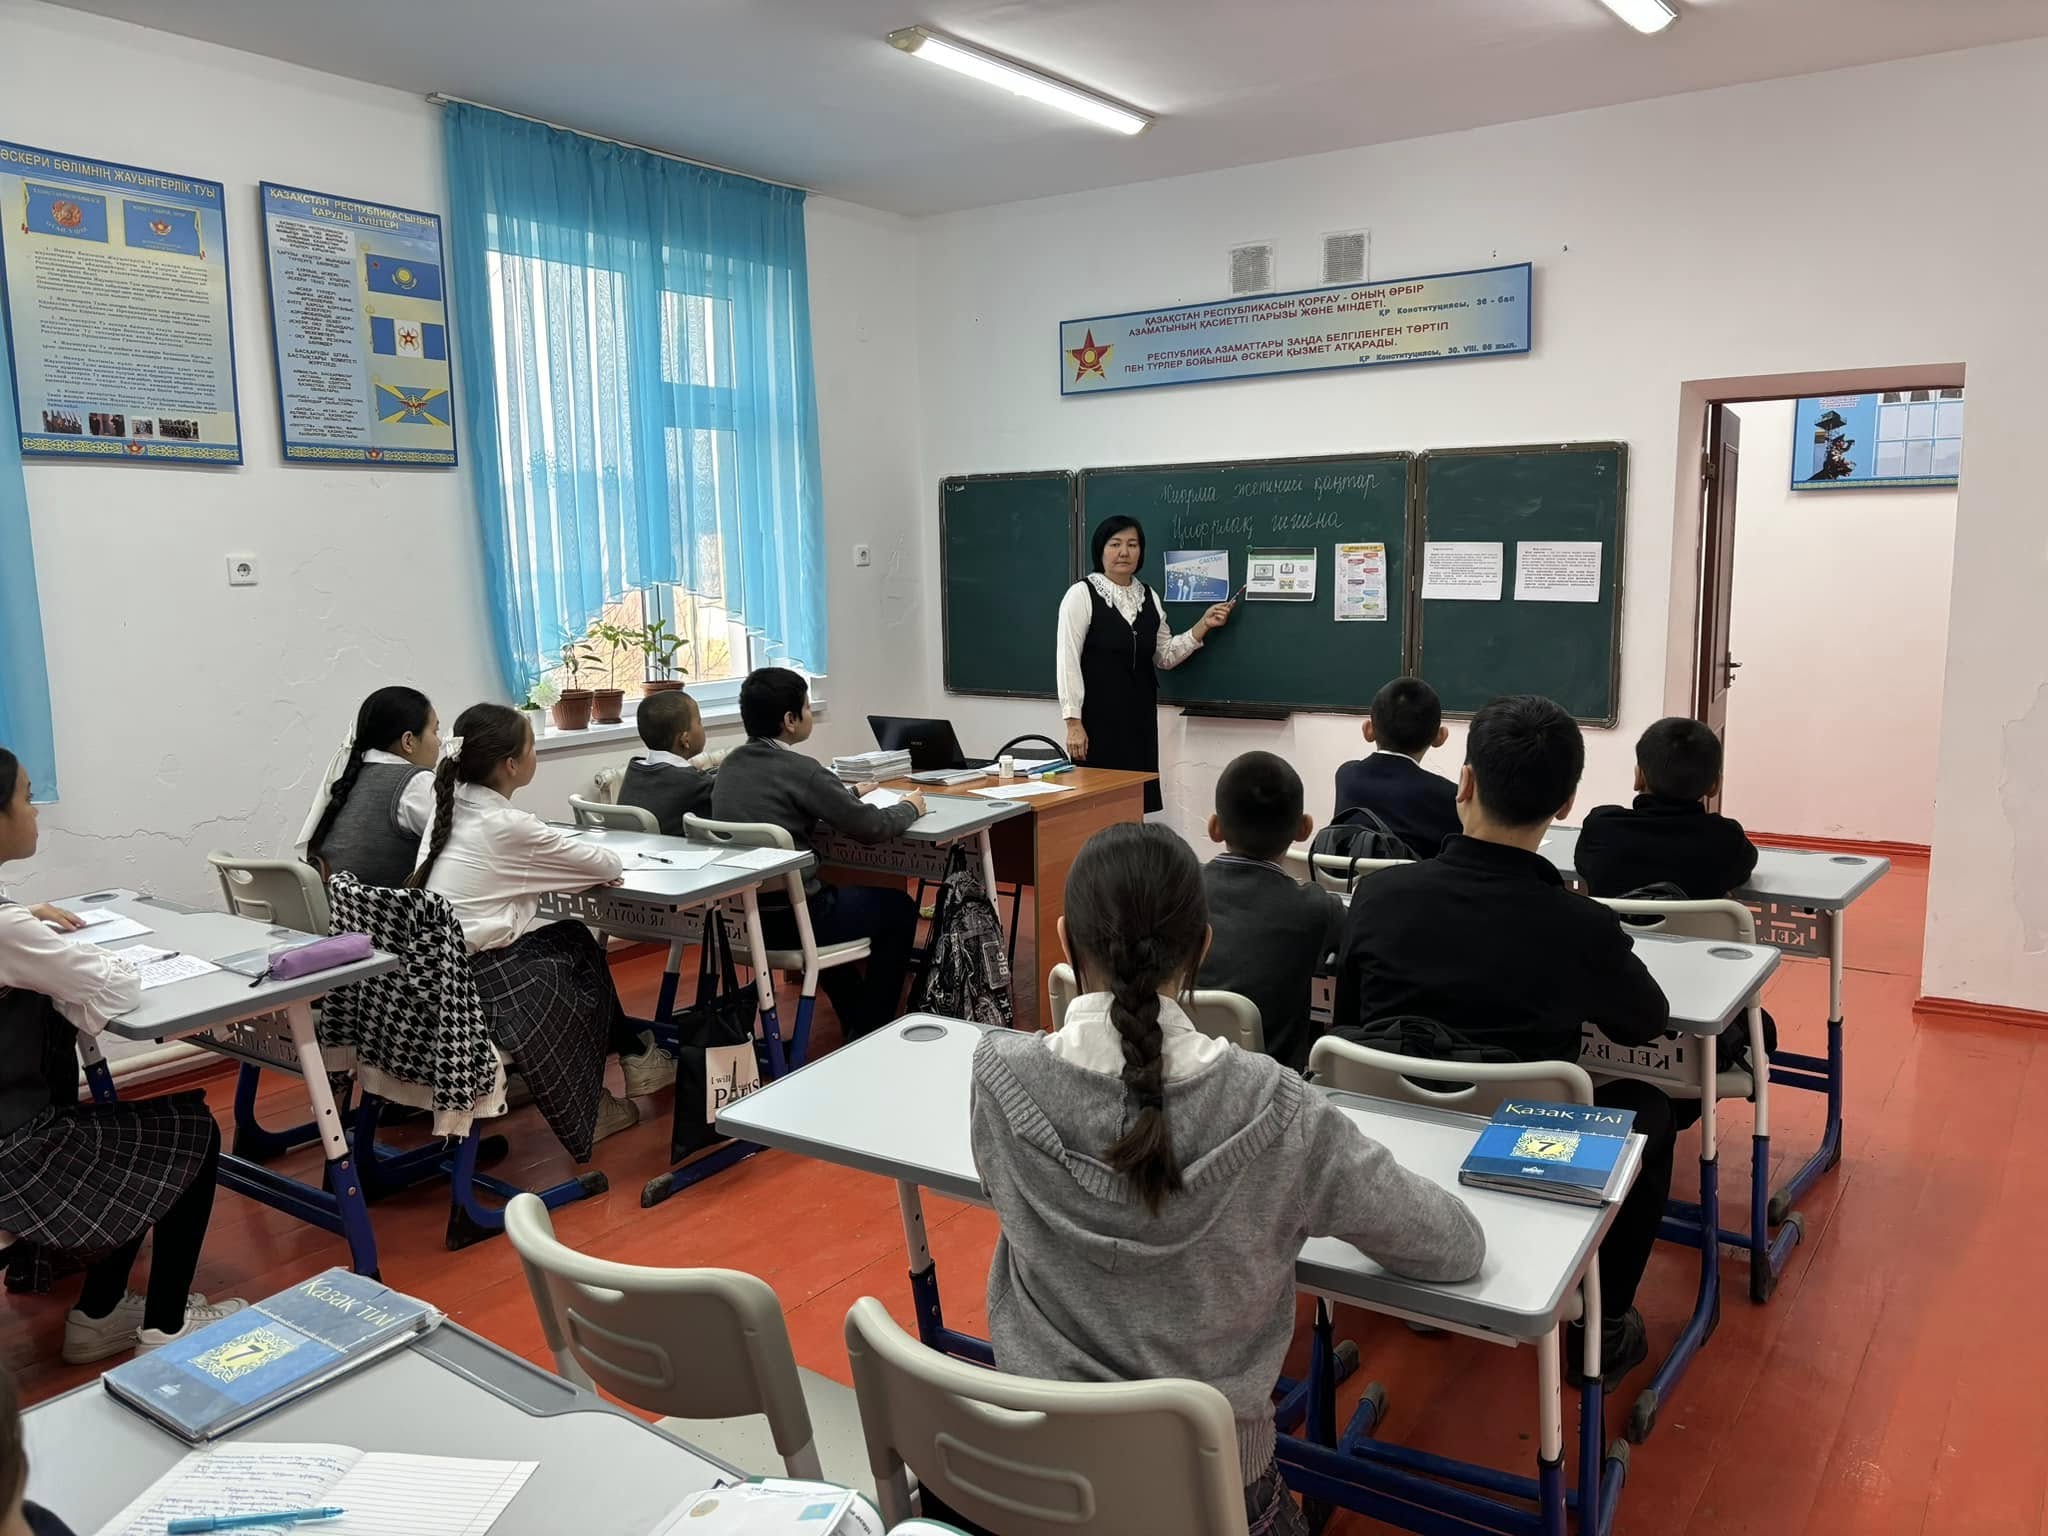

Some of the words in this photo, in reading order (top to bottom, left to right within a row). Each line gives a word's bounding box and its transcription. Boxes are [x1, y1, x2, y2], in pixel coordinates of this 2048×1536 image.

[54, 159, 112, 181] БӨЛІМНІҢ
[114, 168, 191, 193] ЖАУЫНГЕРЛІК
[194, 184, 215, 198] ТУЫ
[1128, 323, 1197, 337] АЗАМАТЫНЫҢ
[1200, 315, 1249, 329] ҚАСИЕТТІ
[1251, 311, 1297, 322] ПАРЫЗЫ
[1336, 300, 1386, 313] МІНДЕТІ.
[1145, 311, 1200, 326] ҚАЗАҚСТАН
[1203, 300, 1295, 319] РЕСПУБЛИКАСЫН
[1298, 294, 1341, 309] ҚОРҒАУ
[1351, 289, 1386, 301] ОНЫҢ
[1124, 364, 1144, 373] ПЕН
[1147, 360, 1183, 371] ТҮРЛЕР
[1185, 354, 1239, 367] БОЙЫНША
[1286, 344, 1330, 358] ҚЫЗМЕТ
[1334, 338, 1398, 352] АТҚАРАДЫ.
[1147, 347, 1212, 361] РЕСПУБЛИКА
[1215, 340, 1284, 354] АЗАМАТТАРЫ
[1287, 335, 1323, 347] ЗАҢДА
[1326, 327, 1403, 341] БЕЛГІЛЕНГЕН
[1581, 1111, 1623, 1125] тілі
[1537, 1141, 1556, 1152] 7
